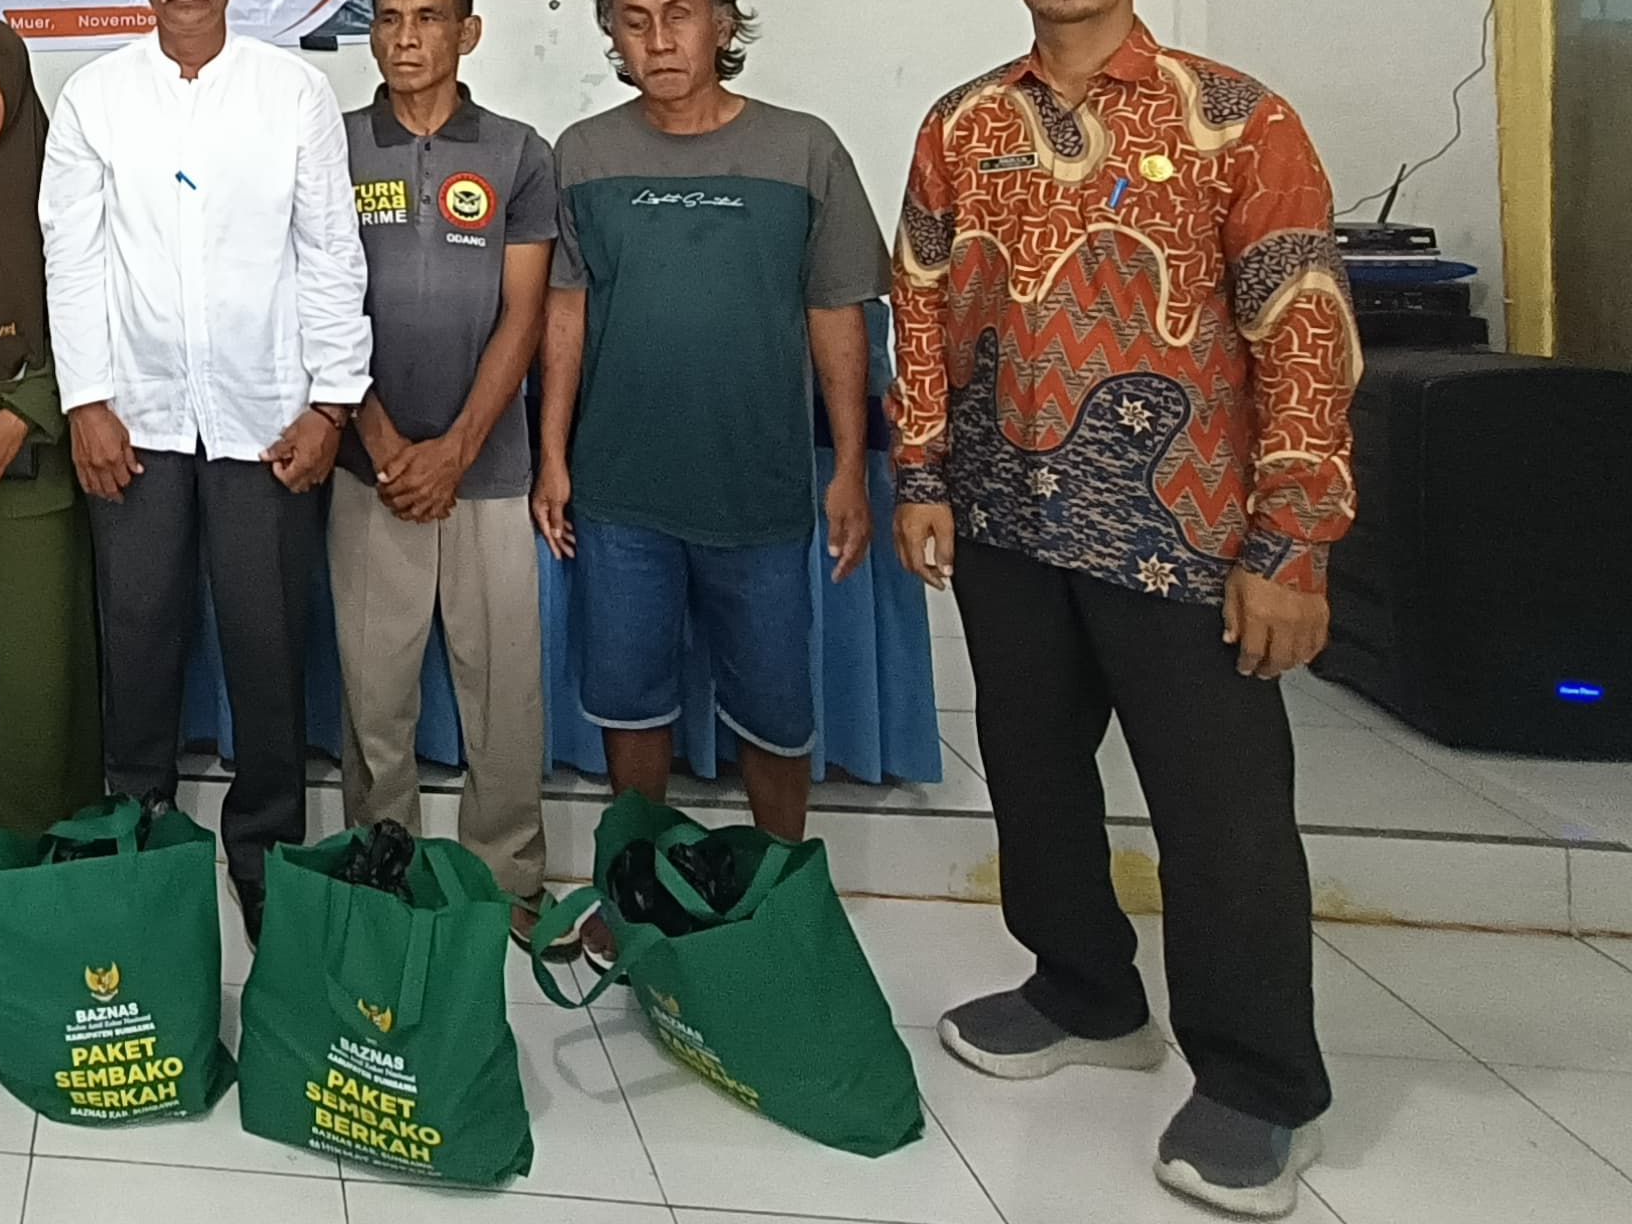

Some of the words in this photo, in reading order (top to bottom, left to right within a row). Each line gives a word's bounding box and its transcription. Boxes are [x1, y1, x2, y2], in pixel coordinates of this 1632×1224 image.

[10, 16, 56, 30] Muer,
[78, 13, 157, 27] Novembe
[361, 208, 408, 226] RIME
[75, 1002, 139, 1025] BAZNAS
[71, 1036, 157, 1068] PAKET
[339, 1036, 405, 1071] BAZNAS
[54, 1056, 185, 1089] SEMBAKO
[69, 1081, 178, 1108] BERKAH
[327, 1068, 416, 1119] PAKET
[304, 1080, 442, 1146] SEMBAKO
[314, 1106, 431, 1163] BERKAH
